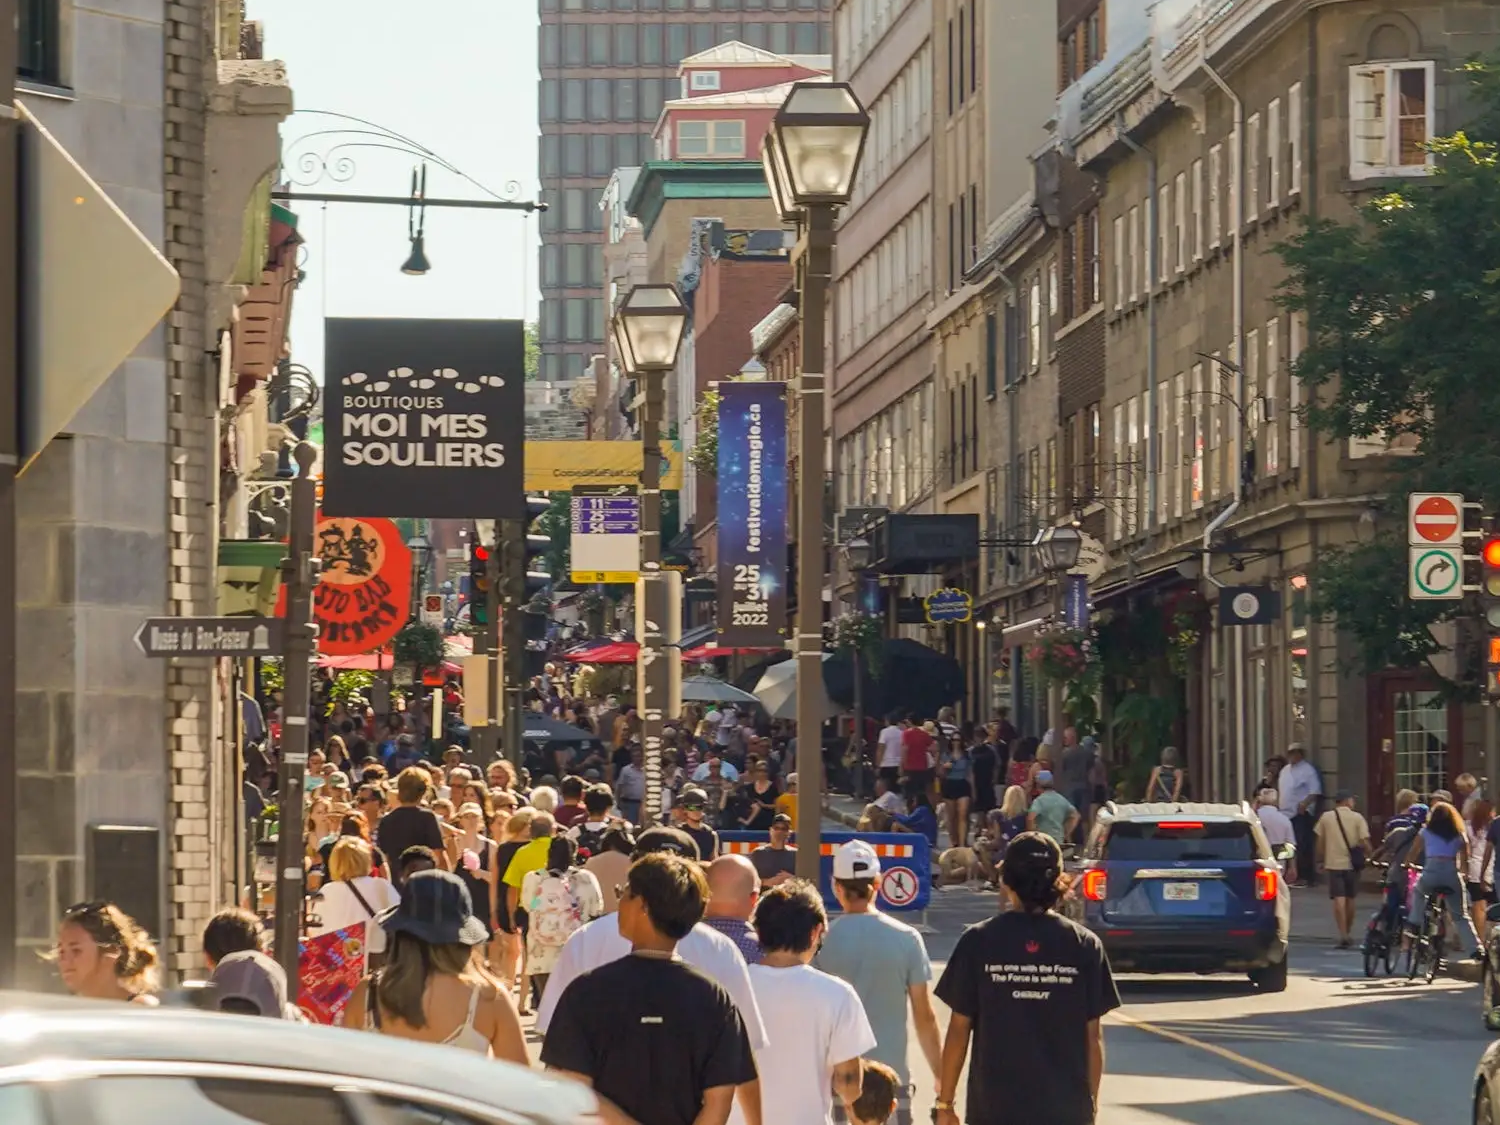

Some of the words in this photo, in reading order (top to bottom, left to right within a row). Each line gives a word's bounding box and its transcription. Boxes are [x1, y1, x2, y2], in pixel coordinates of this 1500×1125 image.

[343, 395, 444, 410] BOUTIQUES
[342, 413, 407, 437] MOI
[421, 413, 488, 438] MES
[342, 441, 506, 467] SOULIERS
[746, 403, 763, 553] festivaldemagie.ca
[590, 498, 604, 509] 11
[734, 564, 761, 582] 25
[746, 582, 769, 600] 31
[732, 601, 769, 614] juillet
[732, 613, 769, 626] 2022
